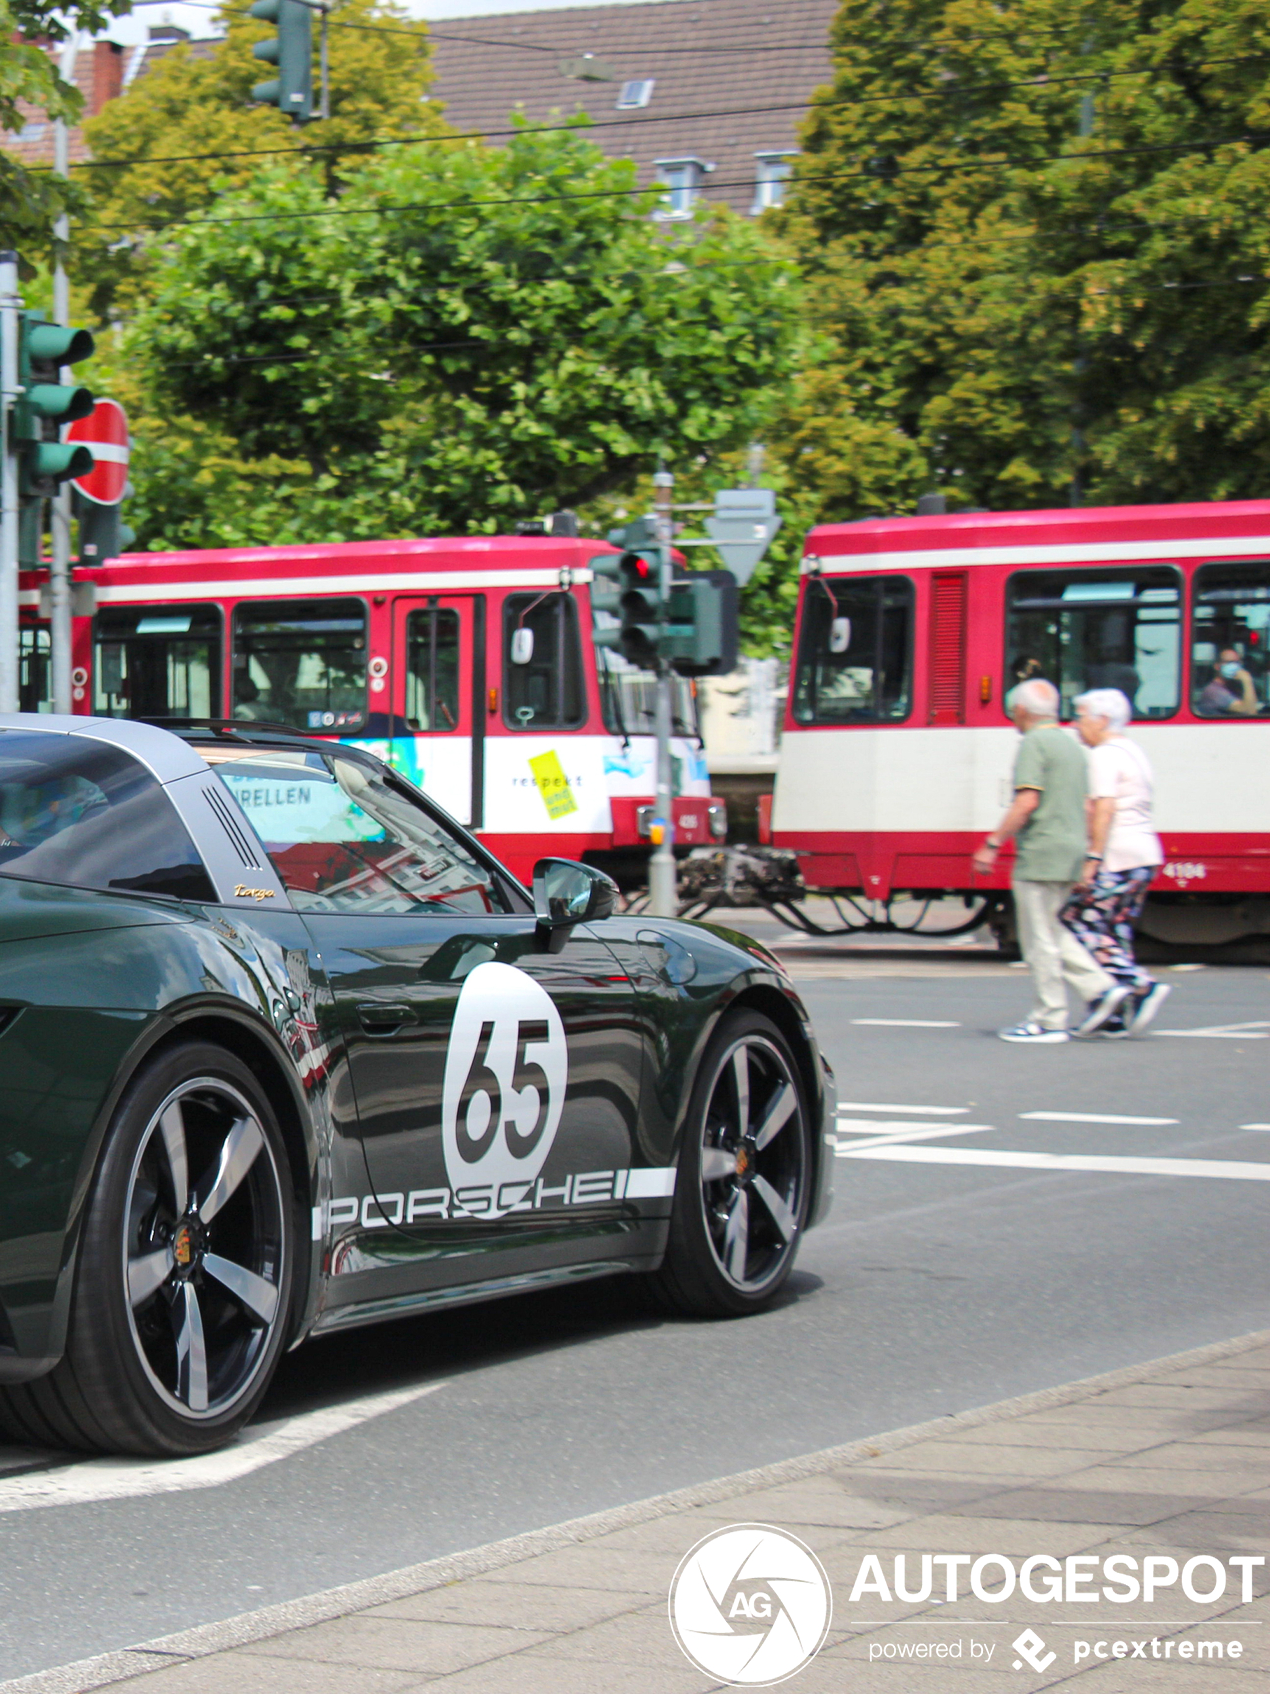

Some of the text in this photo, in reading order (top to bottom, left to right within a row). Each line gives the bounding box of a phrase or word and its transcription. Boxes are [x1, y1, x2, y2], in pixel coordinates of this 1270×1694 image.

[512, 775, 582, 789] respekt
[234, 883, 277, 902] Targa
[455, 1019, 550, 1164] 65
[328, 1170, 615, 1229] PORSCHE
